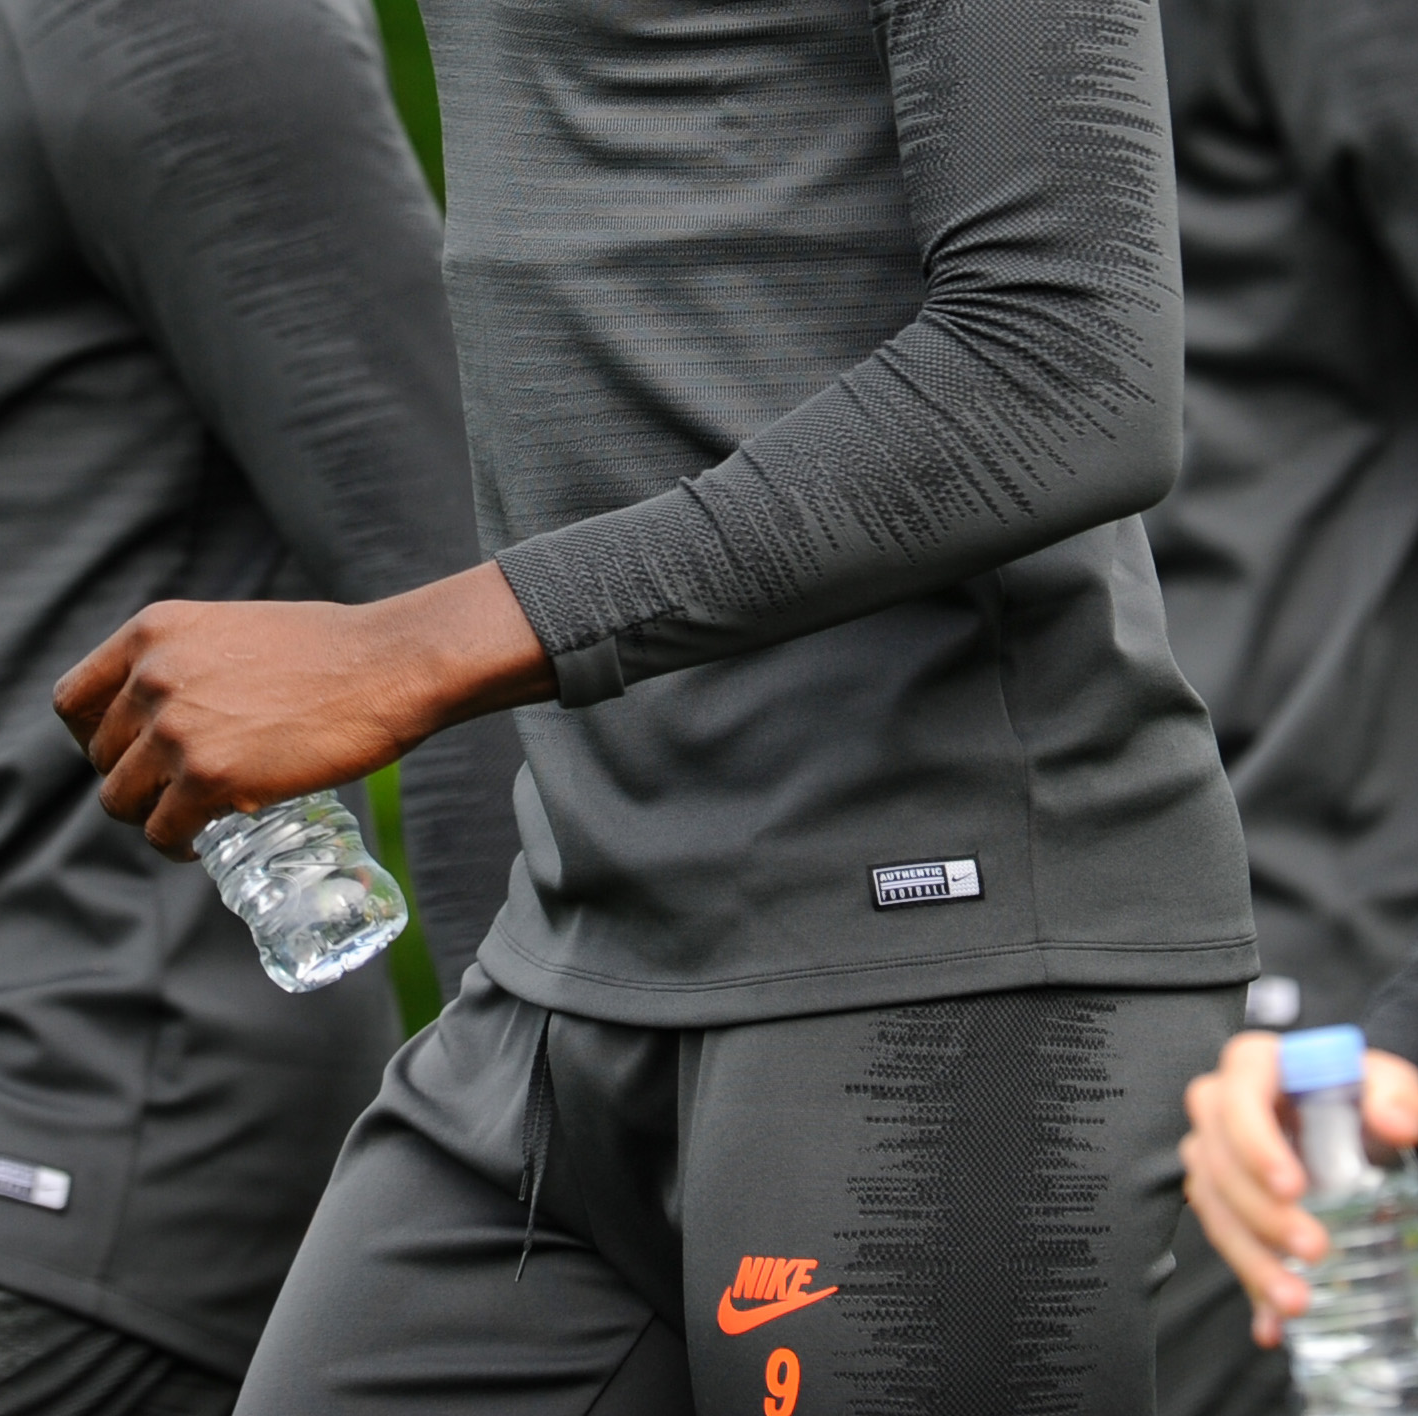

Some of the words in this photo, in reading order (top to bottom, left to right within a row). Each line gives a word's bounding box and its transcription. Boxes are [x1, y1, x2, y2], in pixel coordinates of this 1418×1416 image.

[879, 867, 943, 882] AUTHENTIC
[881, 884, 947, 901] FOOTBALL
[732, 1255, 819, 1301] NIKE
[763, 1347, 801, 1416] 9
